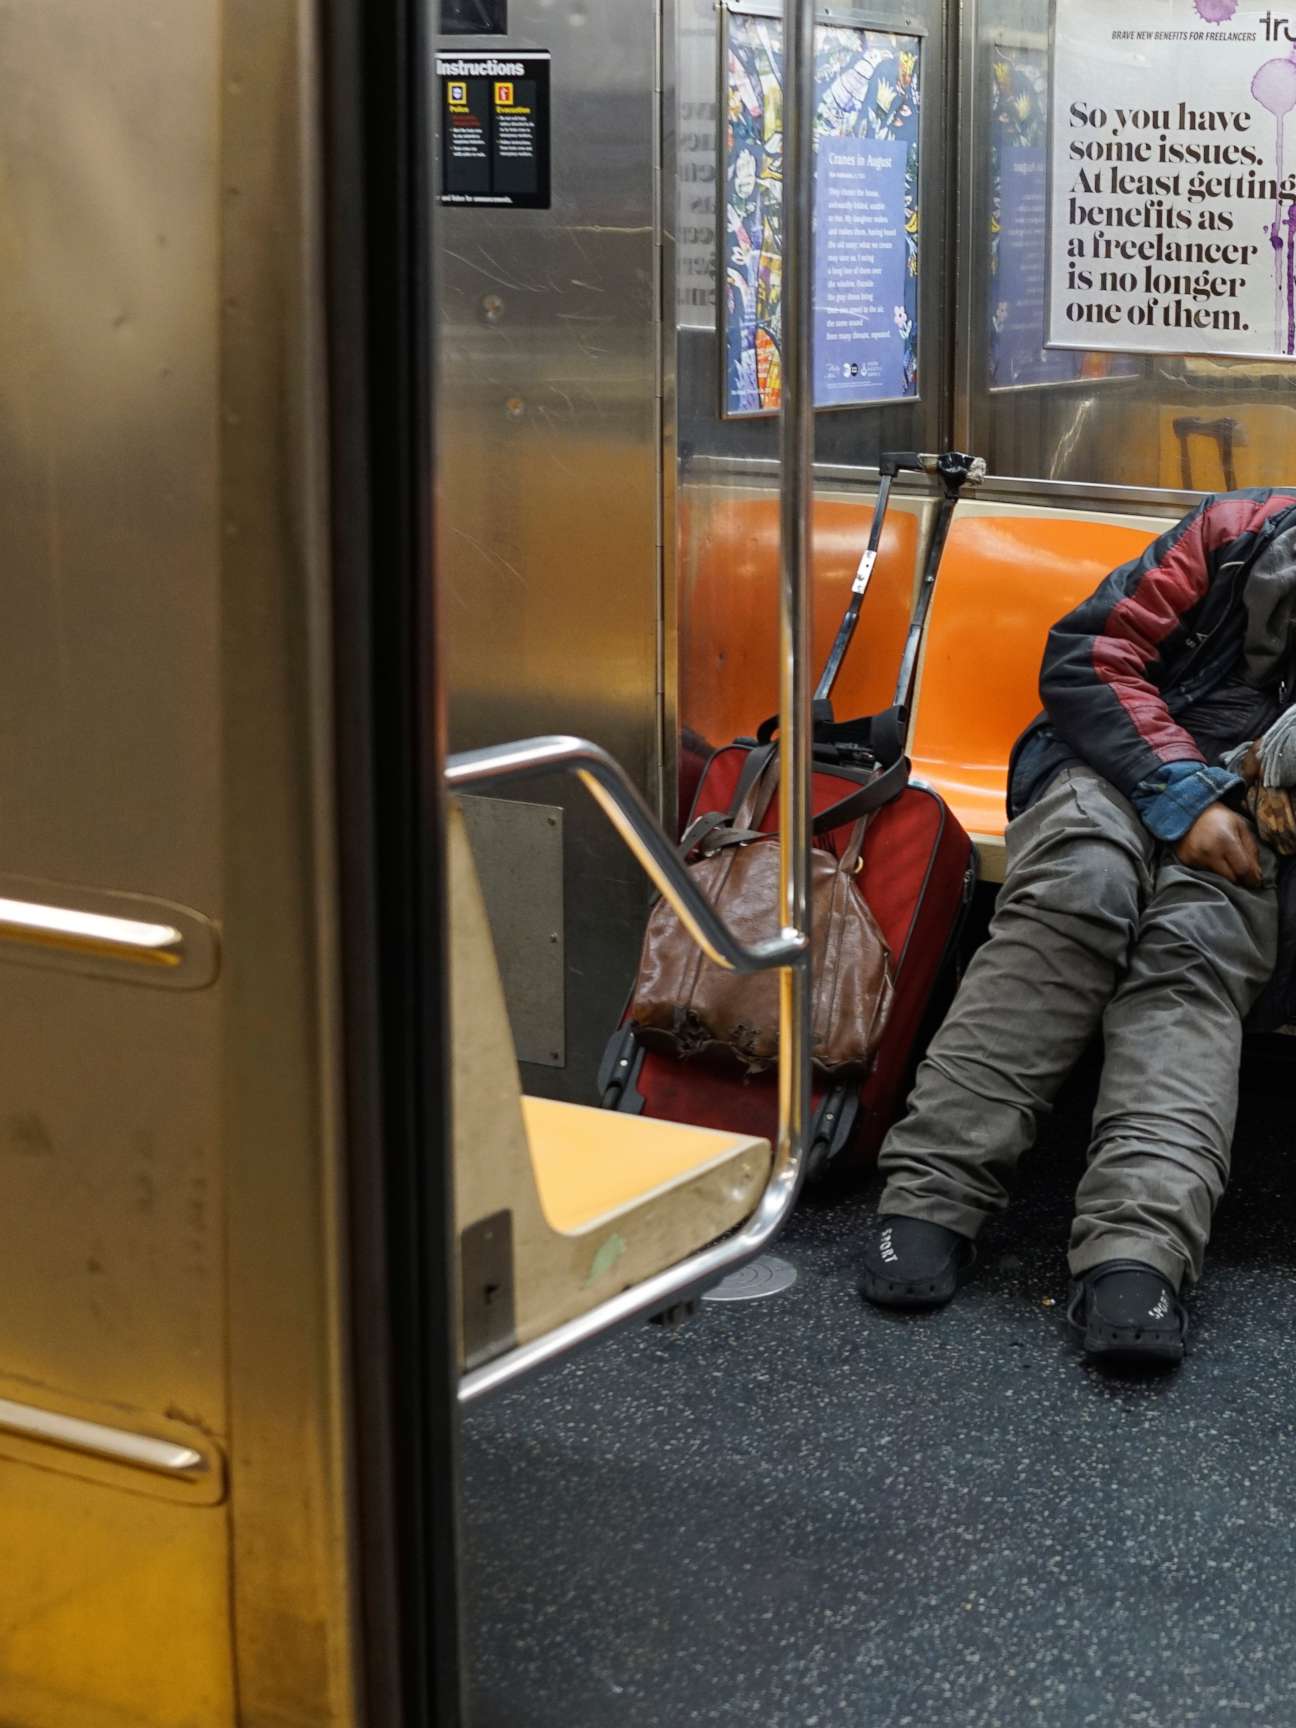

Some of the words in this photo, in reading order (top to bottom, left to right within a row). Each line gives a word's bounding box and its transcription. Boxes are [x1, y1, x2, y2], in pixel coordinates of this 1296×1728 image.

[1111, 30, 1135, 41] BRAVE
[1136, 30, 1153, 41] NEW
[1154, 31, 1188, 41] BENEFITS
[1189, 31, 1204, 41] FOR
[1205, 32, 1257, 42] FREELANCERS
[436, 59, 525, 76] Instructions
[1069, 101, 1107, 129] So
[1112, 108, 1171, 136] you
[1178, 101, 1251, 132] have
[1069, 140, 1152, 162] some
[1158, 134, 1264, 166] issues.
[1069, 166, 1103, 193] At
[1110, 166, 1181, 197] least
[1069, 198, 1193, 230] benefits
[1198, 209, 1234, 232] as
[1067, 237, 1086, 258] a
[1092, 230, 1259, 265] freelancer
[1067, 261, 1094, 290] is
[1100, 270, 1138, 293] no
[1144, 265, 1247, 303] longer
[1066, 302, 1122, 325] one
[1127, 298, 1158, 327] of
[1162, 299, 1250, 332] them.
[879, 1227, 899, 1263] SPORT
